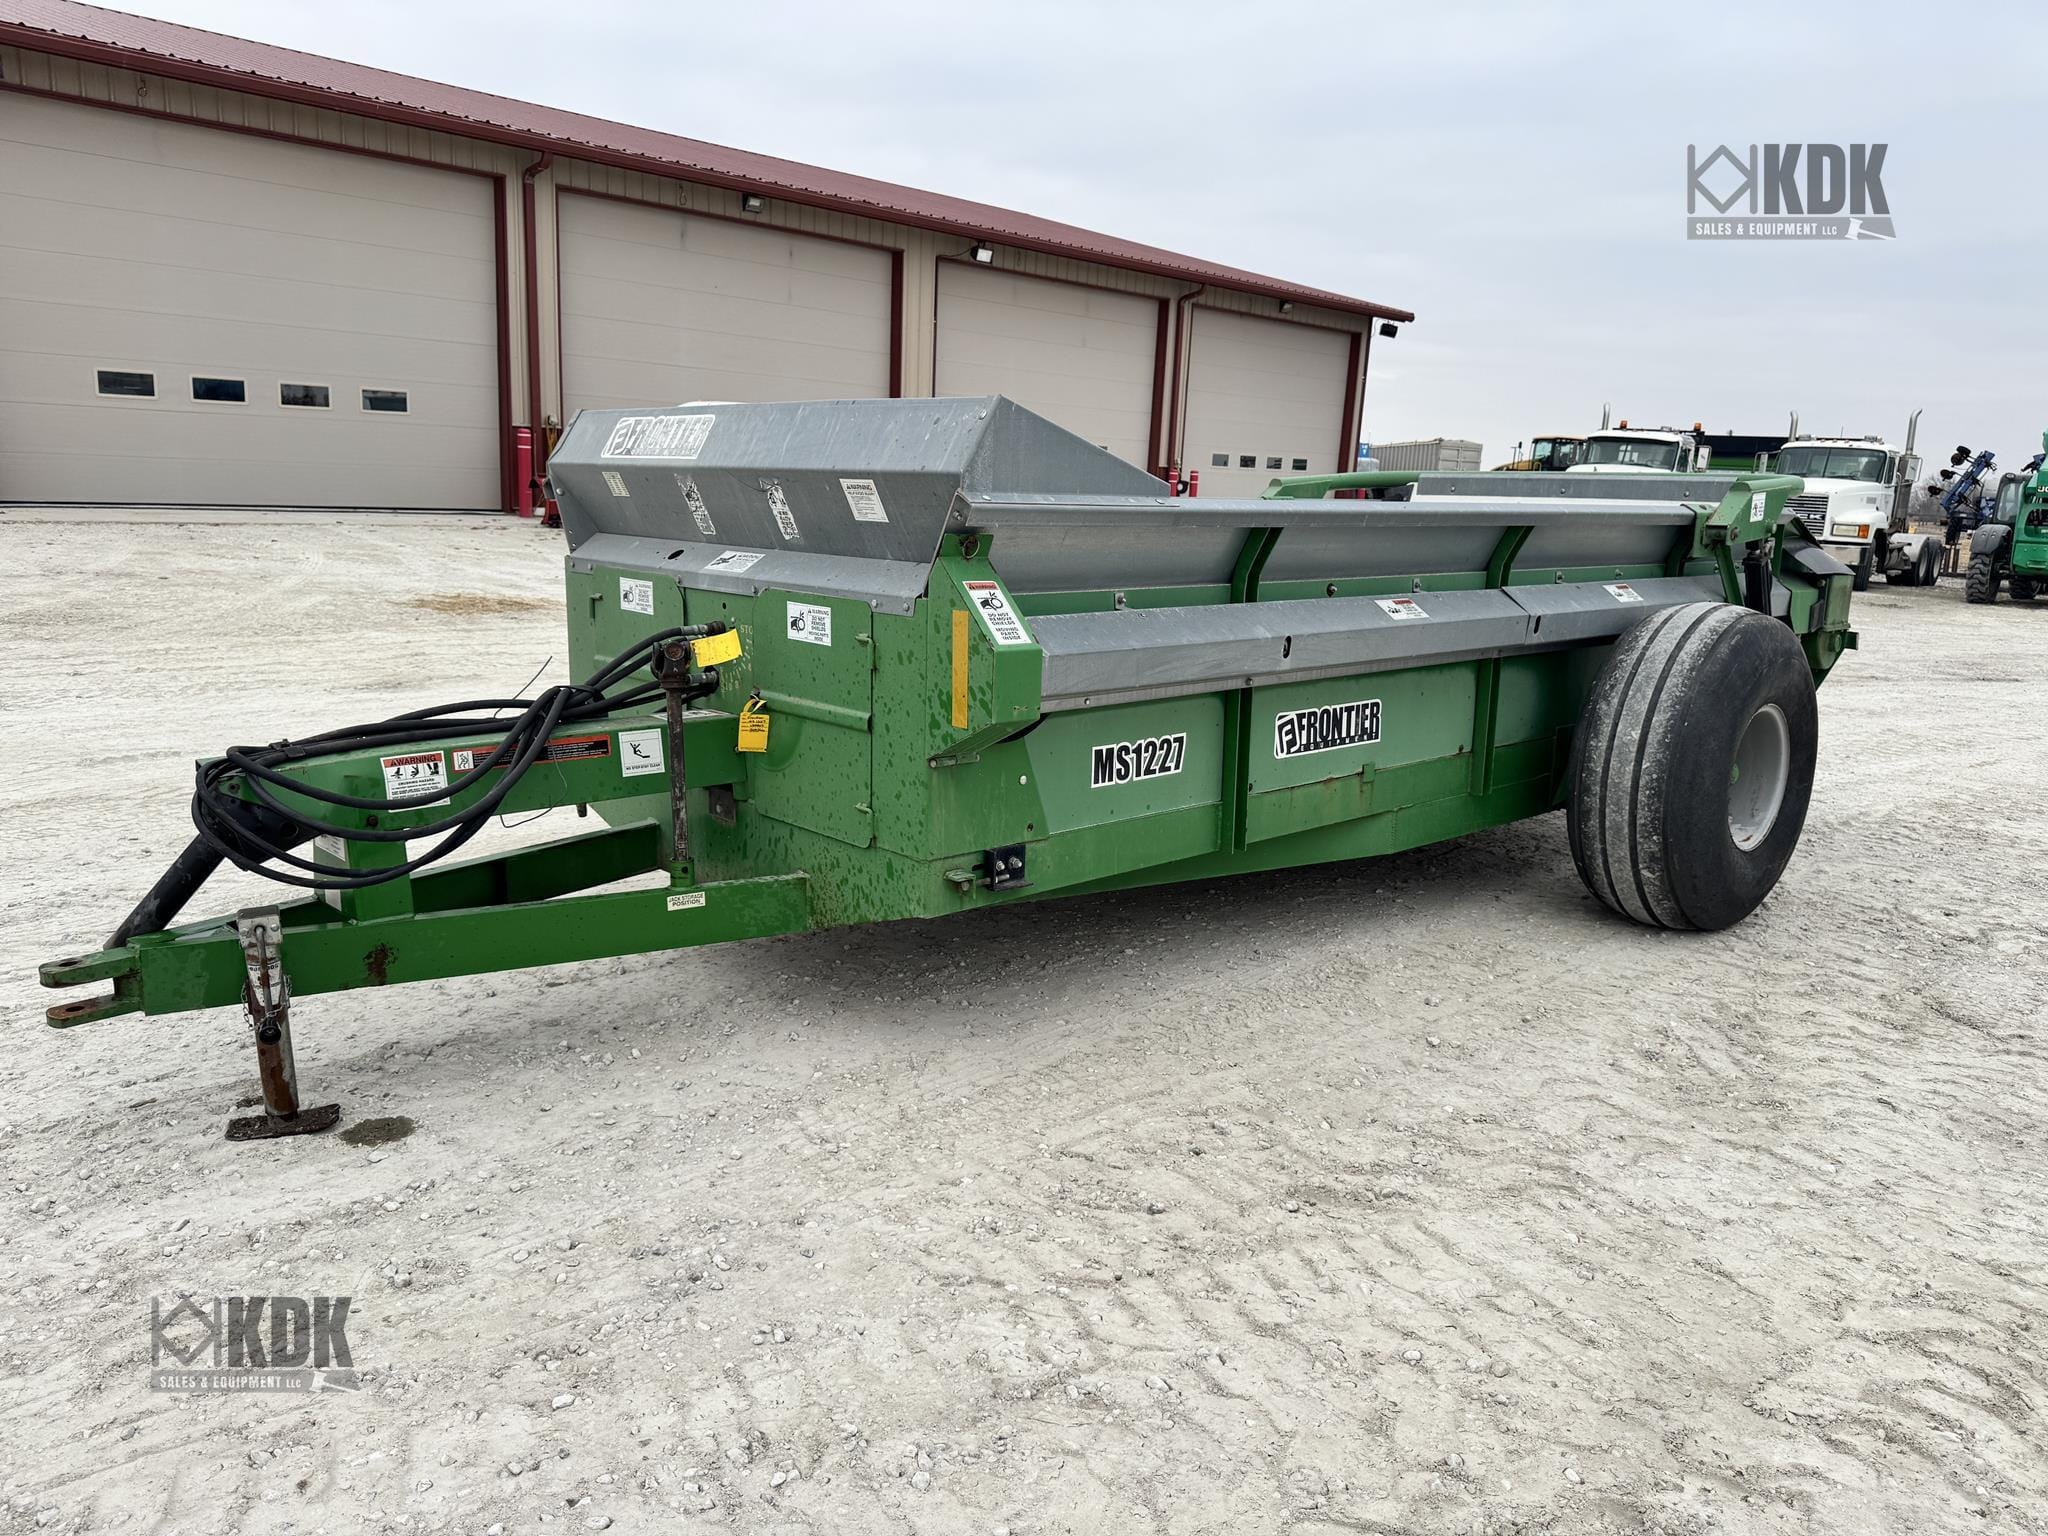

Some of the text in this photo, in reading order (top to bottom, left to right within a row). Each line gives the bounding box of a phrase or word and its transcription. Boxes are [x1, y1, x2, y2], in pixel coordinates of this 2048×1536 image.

[627, 415, 714, 450] FRONTIER
[1295, 701, 1380, 745] FRONTIER
[1300, 733, 1376, 752] EQUIPMENT
[396, 754, 436, 767] WARNING
[1092, 735, 1185, 786] MS1227
[672, 899, 700, 907] POSITION
